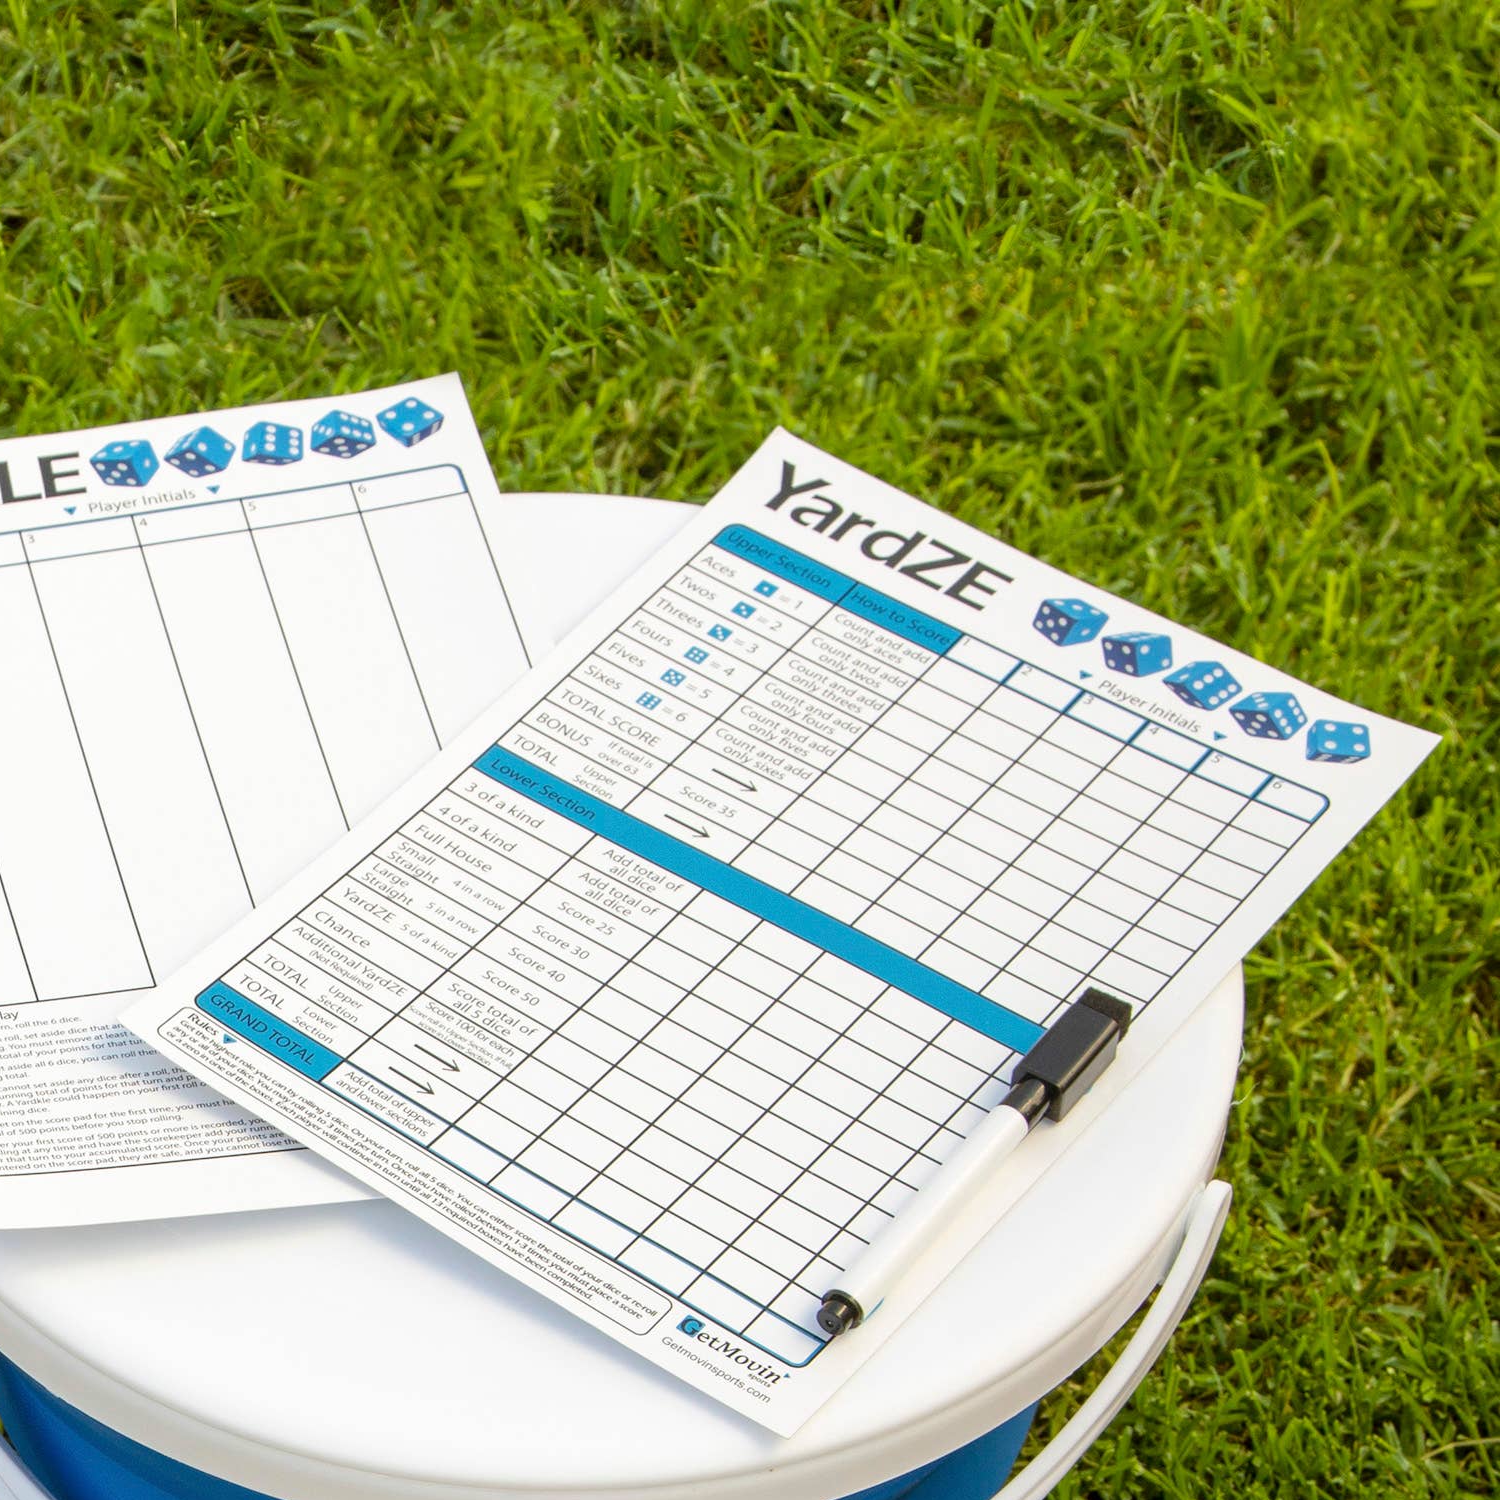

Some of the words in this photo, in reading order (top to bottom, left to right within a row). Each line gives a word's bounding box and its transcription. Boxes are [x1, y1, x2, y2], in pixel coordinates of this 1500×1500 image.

[88, 498, 138, 514] Player
[141, 488, 197, 506] Initials
[357, 483, 367, 494] 6
[138, 514, 148, 527] 4
[247, 500, 257, 512] 5
[27, 530, 37, 544] 3
[764, 459, 1015, 612] YardZE
[700, 555, 737, 578] Aces
[727, 530, 777, 560] Upper
[773, 554, 832, 589] Section
[679, 574, 717, 601] Twos
[655, 596, 704, 629] Threes
[849, 590, 889, 615] How
[887, 609, 909, 624] to
[905, 618, 952, 646] Score
[631, 619, 674, 647] Fours
[834, 613, 876, 639] Count
[874, 634, 905, 652] and
[902, 648, 932, 665] add
[842, 631, 874, 650] only
[872, 646, 903, 665] aces
[962, 636, 975, 647] 1
[607, 641, 646, 668] Fives
[1020, 664, 1037, 677] 2
[583, 664, 623, 691] Sixes
[1082, 693, 1099, 705] 3
[1097, 679, 1148, 708] Player
[1147, 702, 1202, 733] Initials
[535, 711, 593, 747] BONUS
[561, 688, 606, 721] TOTAL
[607, 715, 661, 748] SCORE
[1148, 725, 1162, 736] 4
[513, 734, 559, 767] TOTAL
[597, 751, 623, 768] over
[622, 764, 640, 776] 63
[607, 740, 620, 750] If
[616, 746, 645, 764] total
[643, 759, 654, 769] is
[1210, 751, 1228, 764] 5
[490, 758, 541, 790] Lower
[537, 783, 596, 821] Section
[572, 774, 613, 800] Section
[582, 764, 618, 787] Upper
[1272, 777, 1289, 790] 6
[464, 782, 478, 793] 3
[477, 791, 500, 803] of
[494, 800, 507, 810] a
[506, 804, 546, 829] kind
[679, 785, 717, 810] Score
[717, 804, 738, 818] 35
[414, 824, 446, 845] Full
[443, 840, 493, 873] House
[450, 814, 472, 826] of
[479, 828, 518, 853] kind
[386, 850, 440, 885] Straight
[397, 841, 437, 867] Small
[601, 848, 634, 868] Add
[632, 863, 667, 885] total
[664, 881, 685, 893] of
[361, 871, 414, 906] Straight
[372, 862, 410, 888] Large
[609, 865, 629, 878] all
[627, 875, 657, 894] dice
[343, 887, 397, 924] YardZE
[460, 883, 474, 895] in
[482, 896, 506, 912] row
[314, 911, 371, 949] Chance
[434, 906, 447, 917] in
[455, 919, 479, 935] row
[557, 901, 596, 927] Score
[595, 921, 616, 936] 25
[408, 929, 425, 939] of
[430, 940, 459, 960] kind
[531, 924, 570, 950] Score
[569, 945, 591, 960] 30
[263, 953, 309, 990] TOTAL
[291, 926, 363, 970] Additional
[361, 965, 408, 997] YardZE
[308, 949, 331, 966] (Not
[328, 961, 374, 992] Required)
[507, 946, 546, 973] Score
[547, 969, 566, 983] 40
[239, 973, 285, 1010] TOTAL
[328, 984, 364, 1009] Upper
[481, 969, 520, 996] Score
[519, 991, 541, 1007] 50
[14, 1021, 31, 1029] roll
[32, 1020, 49, 1028] the
[58, 1016, 82, 1025] dice.
[187, 1012, 219, 1036] Rules
[302, 1006, 338, 1030] Lower
[317, 994, 359, 1024] Section
[447, 982, 486, 1009] Score
[486, 1005, 521, 1028] total
[518, 1025, 539, 1037] of
[452, 1000, 473, 1013] all
[470, 1009, 483, 1019] 5
[481, 1017, 511, 1037] dice
[210, 994, 268, 1033] GRAND
[268, 1028, 315, 1066] TOTAL
[291, 1015, 334, 1045] Section
[425, 1001, 455, 1022] Score
[455, 1018, 476, 1034] 100
[473, 1029, 490, 1043] for
[488, 1040, 515, 1058] each
[180, 1020, 197, 1033] Get
[194, 1029, 210, 1042] the
[205, 1039, 240, 1062] highest
[238, 1059, 256, 1072] role
[252, 1069, 273, 1082] you
[271, 1079, 288, 1091] can
[286, 1088, 299, 1099] by
[297, 1095, 325, 1115] rolling
[330, 1116, 350, 1130] dice.
[335, 1079, 361, 1095] and
[356, 1090, 388, 1112] lower
[385, 1109, 429, 1137] sections
[344, 1071, 371, 1088] Add
[367, 1084, 394, 1102] total
[390, 1099, 407, 1109] of
[402, 1106, 436, 1128] upper
[6, 1128, 17, 1137] of
[18, 1127, 37, 1136] 500
[38, 1125, 70, 1134] points
[71, 1121, 104, 1131] before
[126, 1117, 149, 1125] stop
[149, 1113, 184, 1123] rolling.
[678, 1317, 782, 1384] GetMovin
[661, 1336, 771, 1404] Getmovinsports.com
[747, 1373, 772, 1388] sports
